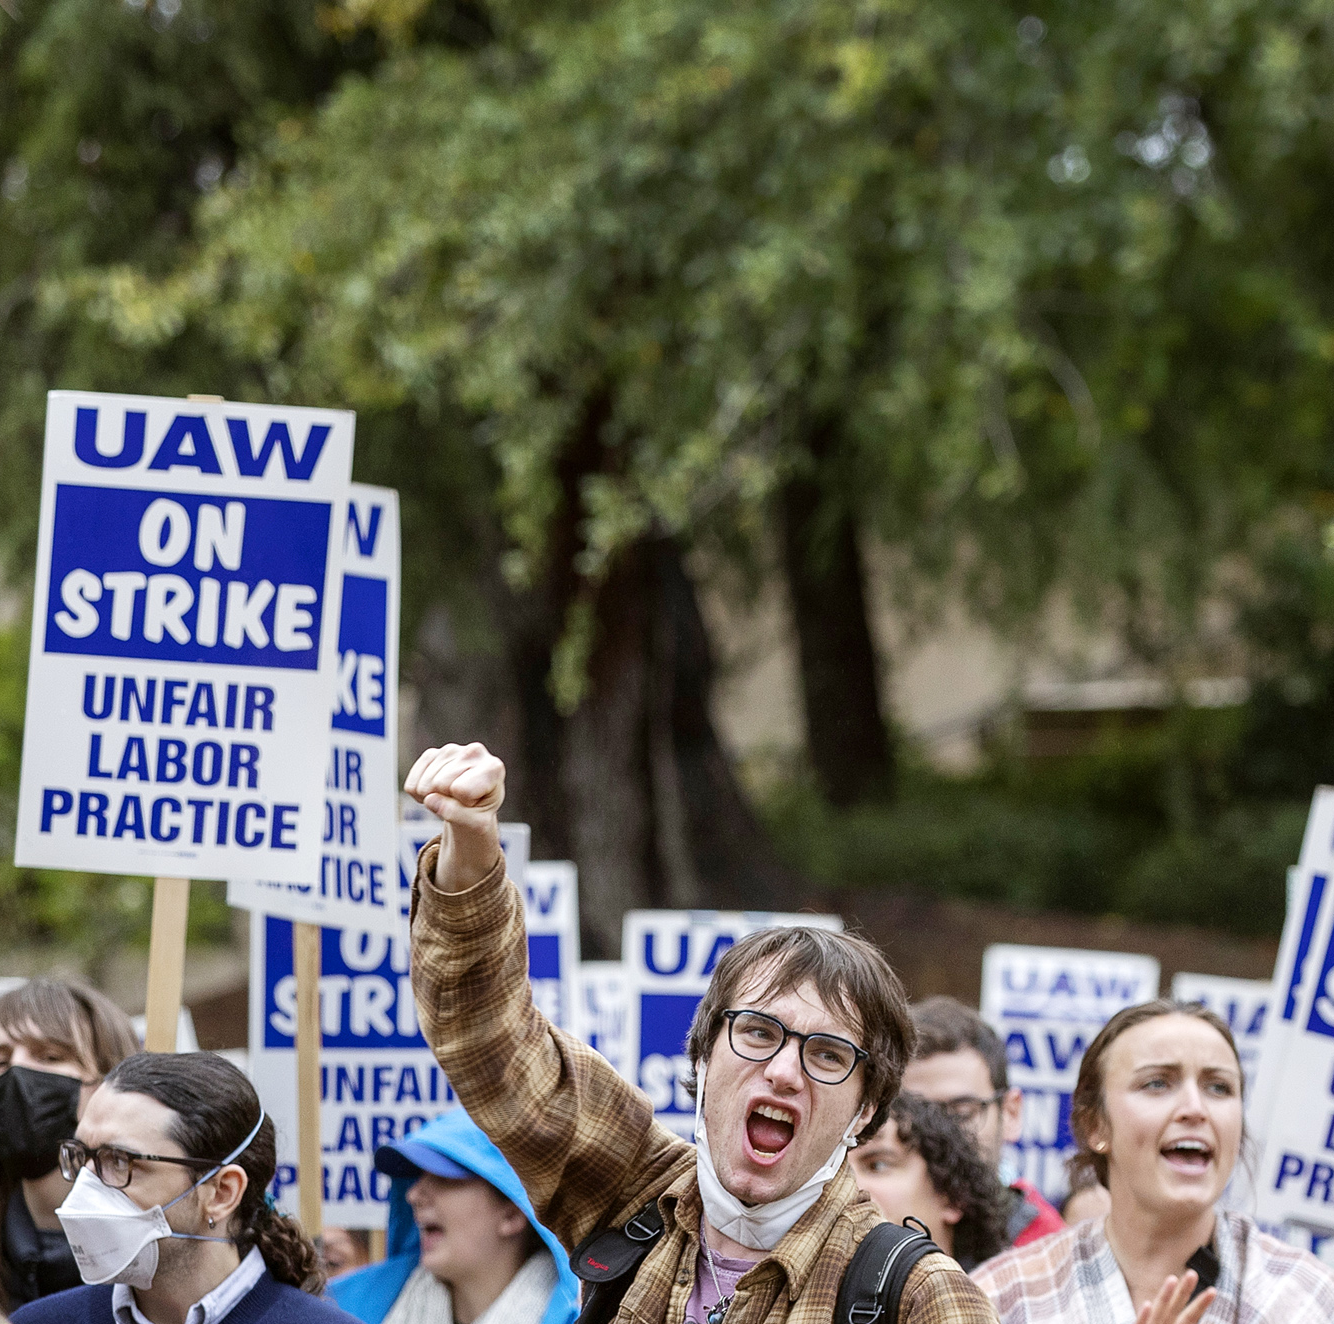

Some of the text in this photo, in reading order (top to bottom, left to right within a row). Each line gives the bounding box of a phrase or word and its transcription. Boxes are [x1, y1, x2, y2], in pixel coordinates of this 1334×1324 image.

[72, 406, 333, 482] UAW
[138, 497, 246, 572] ON
[54, 567, 318, 652] STRIKE
[82, 673, 276, 733] UNFAIR
[88, 731, 260, 789] LABOR
[39, 787, 300, 850] PRACTICE
[269, 974, 421, 1039] STRI
[1001, 968, 1141, 1001] UAW
[321, 1065, 455, 1103] NFAI
